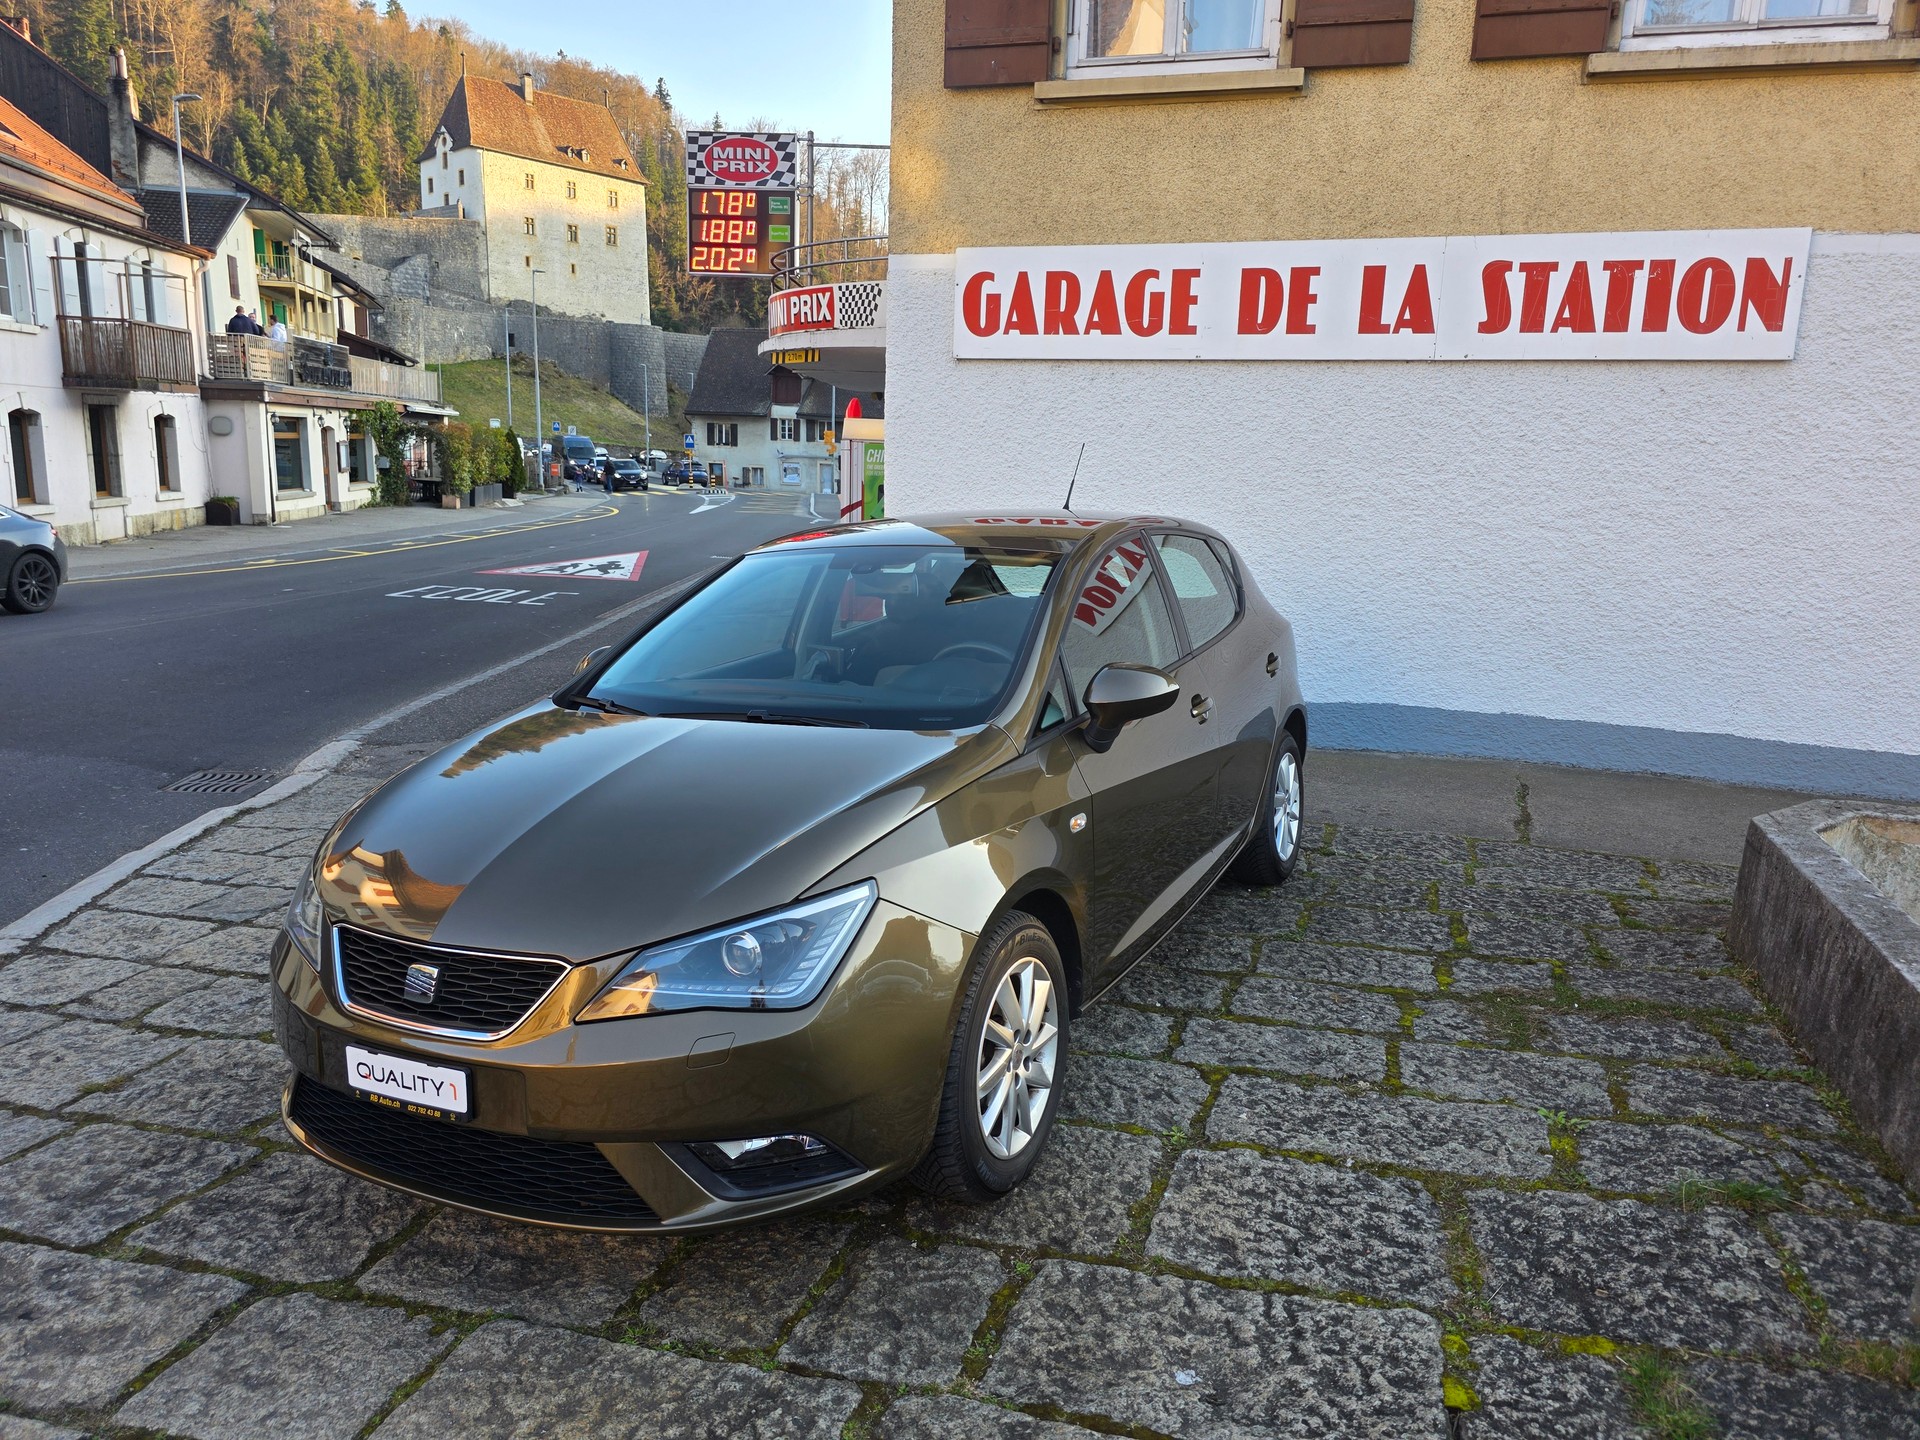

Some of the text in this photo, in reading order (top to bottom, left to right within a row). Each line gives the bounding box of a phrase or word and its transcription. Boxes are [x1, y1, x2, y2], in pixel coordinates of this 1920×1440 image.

[712, 146, 771, 160] MINI
[712, 160, 771, 173] PRIX
[962, 255, 1793, 337] GARAGE DE LA STATION
[770, 291, 832, 329] MINI PRIX
[385, 585, 580, 606] ECOLE
[356, 1061, 445, 1097] QUALITY
[379, 1096, 401, 1109] Auto.ch
